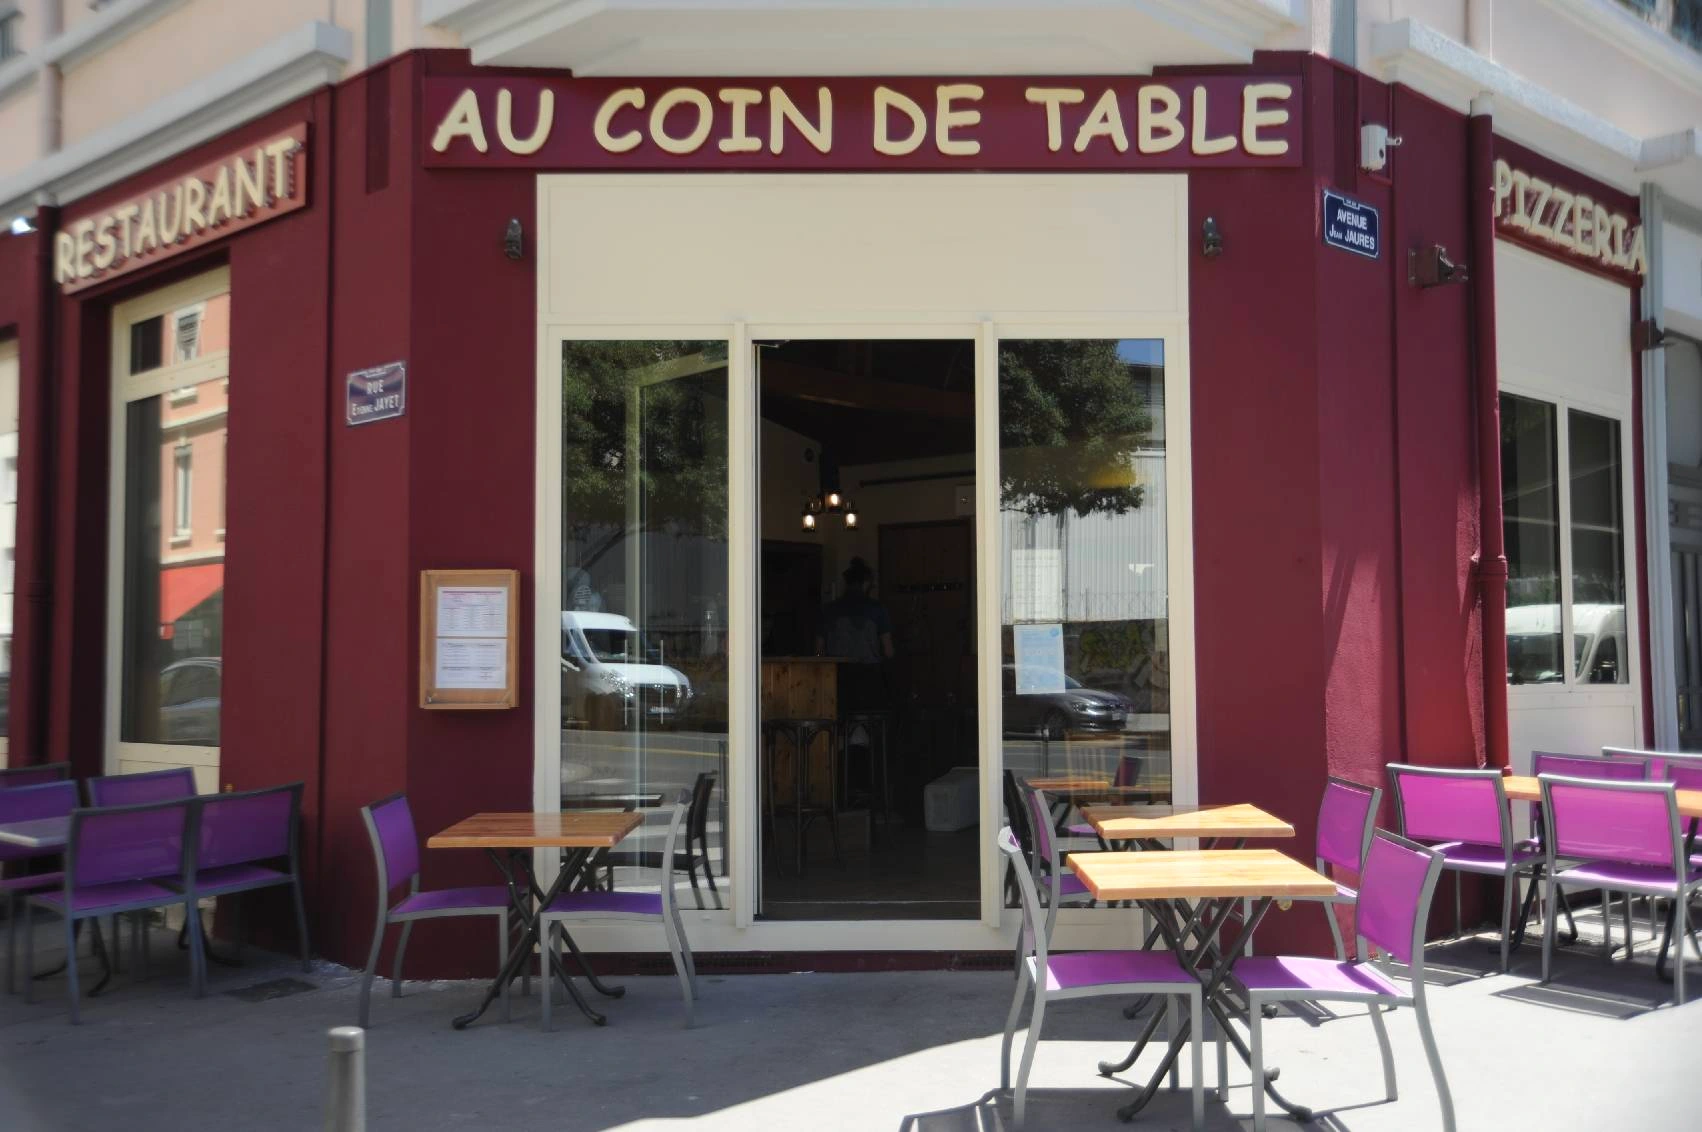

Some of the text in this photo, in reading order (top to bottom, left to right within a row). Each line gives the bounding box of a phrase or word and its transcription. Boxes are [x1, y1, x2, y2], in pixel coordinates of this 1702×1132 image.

[431, 84, 1292, 155] AU COIN DE TABLE
[54, 136, 297, 284] RESTAURANT
[1336, 209, 1367, 230] AVENUE
[1493, 159, 1647, 275] PIZZERIA
[1344, 229, 1375, 250] JAURES
[366, 380, 384, 394] RUE
